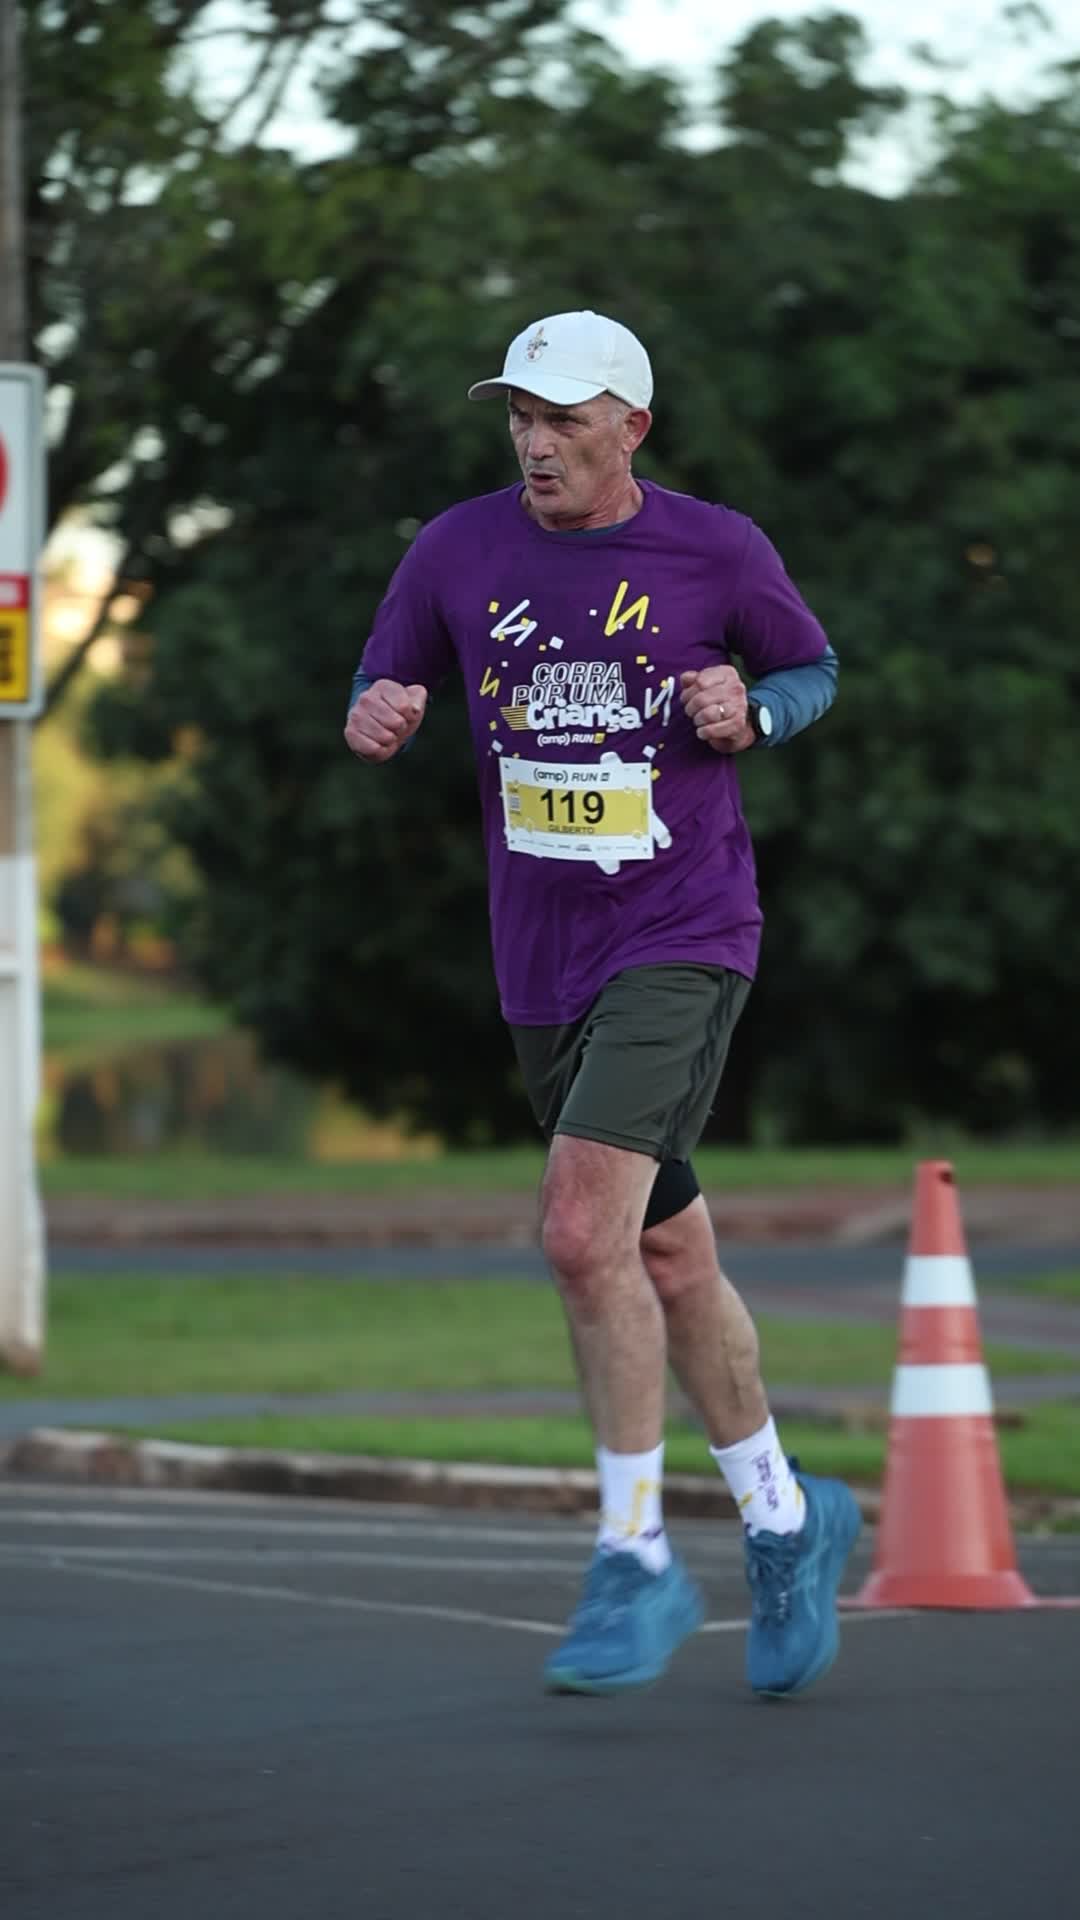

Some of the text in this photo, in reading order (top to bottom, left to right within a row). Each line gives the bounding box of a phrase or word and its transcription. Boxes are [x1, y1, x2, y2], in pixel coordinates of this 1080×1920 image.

[532, 662, 622, 684] CORRA
[512, 682, 627, 706] POR UMA
[527, 698, 642, 733] Criança
[537, 732, 594, 747] (amp) RUN
[533, 768, 598, 783] (amp) RUN
[540, 789, 605, 824] 119
[548, 824, 595, 834] GILBERTO
